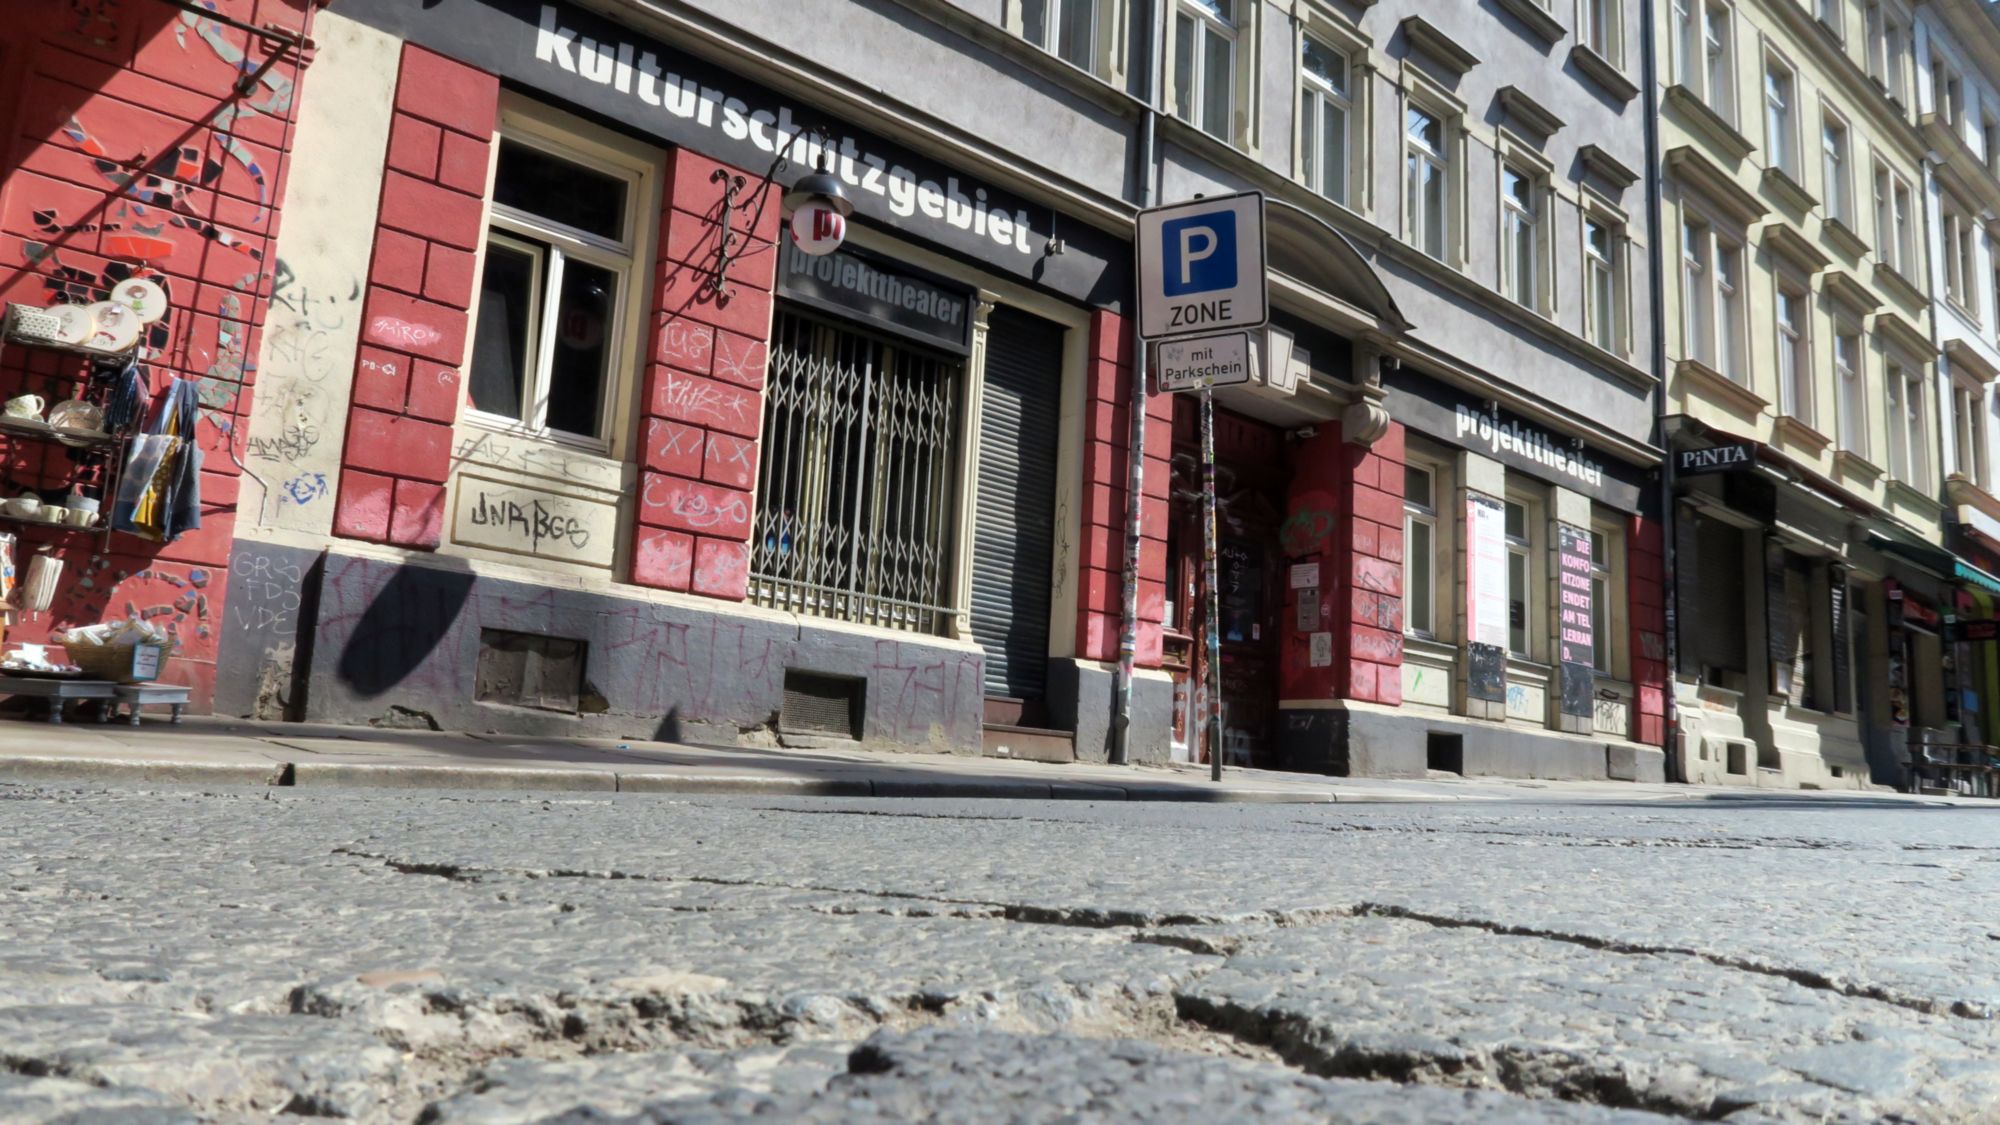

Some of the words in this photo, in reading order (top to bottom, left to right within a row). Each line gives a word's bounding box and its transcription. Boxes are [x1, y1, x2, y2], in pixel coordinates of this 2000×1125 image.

[535, 5, 1032, 255] kulturschutzgebiet
[1179, 226, 1218, 285] P
[791, 243, 962, 325] projekttheater
[1170, 299, 1233, 328] ZONE
[1191, 347, 1214, 362] mit
[1165, 360, 1242, 381] Parkschein
[1455, 403, 1604, 488] projekttheater
[1681, 445, 1749, 469] PiNTA
[1576, 538, 1590, 555] DIE
[1561, 552, 1590, 573] KOMFO
[1562, 571, 1591, 592] RTZONE
[1562, 589, 1591, 610] ENDET
[1562, 611, 1575, 624] AM
[1576, 612, 1591, 628] TEL
[1562, 646, 1573, 661] D.
